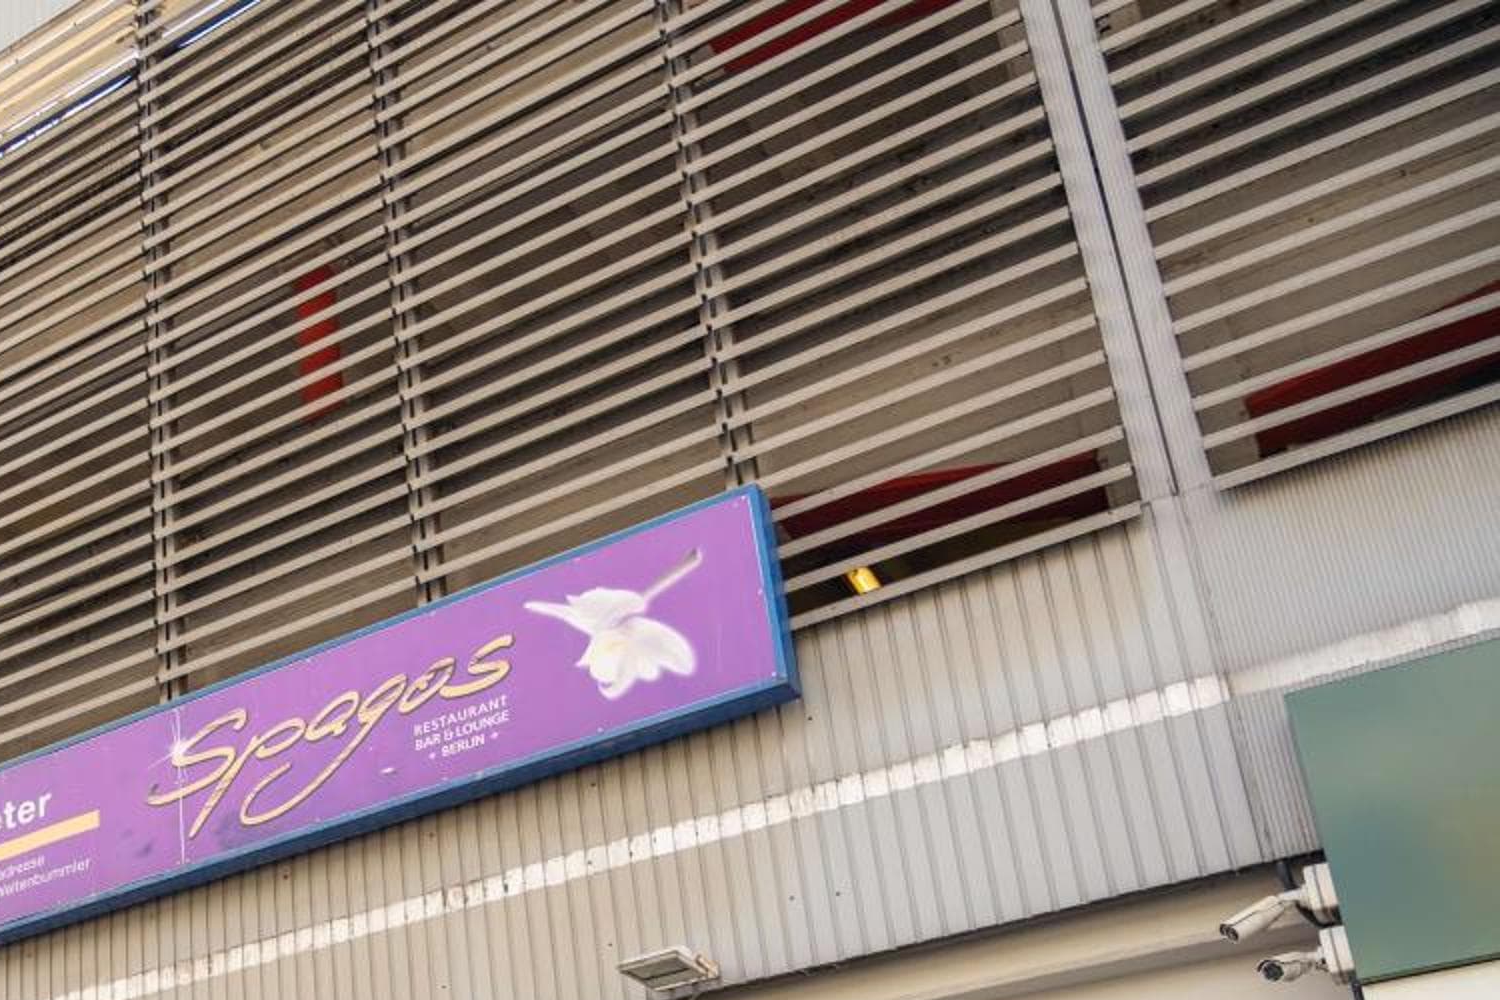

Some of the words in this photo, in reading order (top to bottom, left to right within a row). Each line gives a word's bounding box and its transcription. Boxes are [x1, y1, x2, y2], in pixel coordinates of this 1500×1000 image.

[413, 694, 507, 737] RESTAURANT
[415, 733, 441, 751] BAR
[456, 709, 510, 737] LOUNGE
[441, 733, 485, 757] BERLIN
